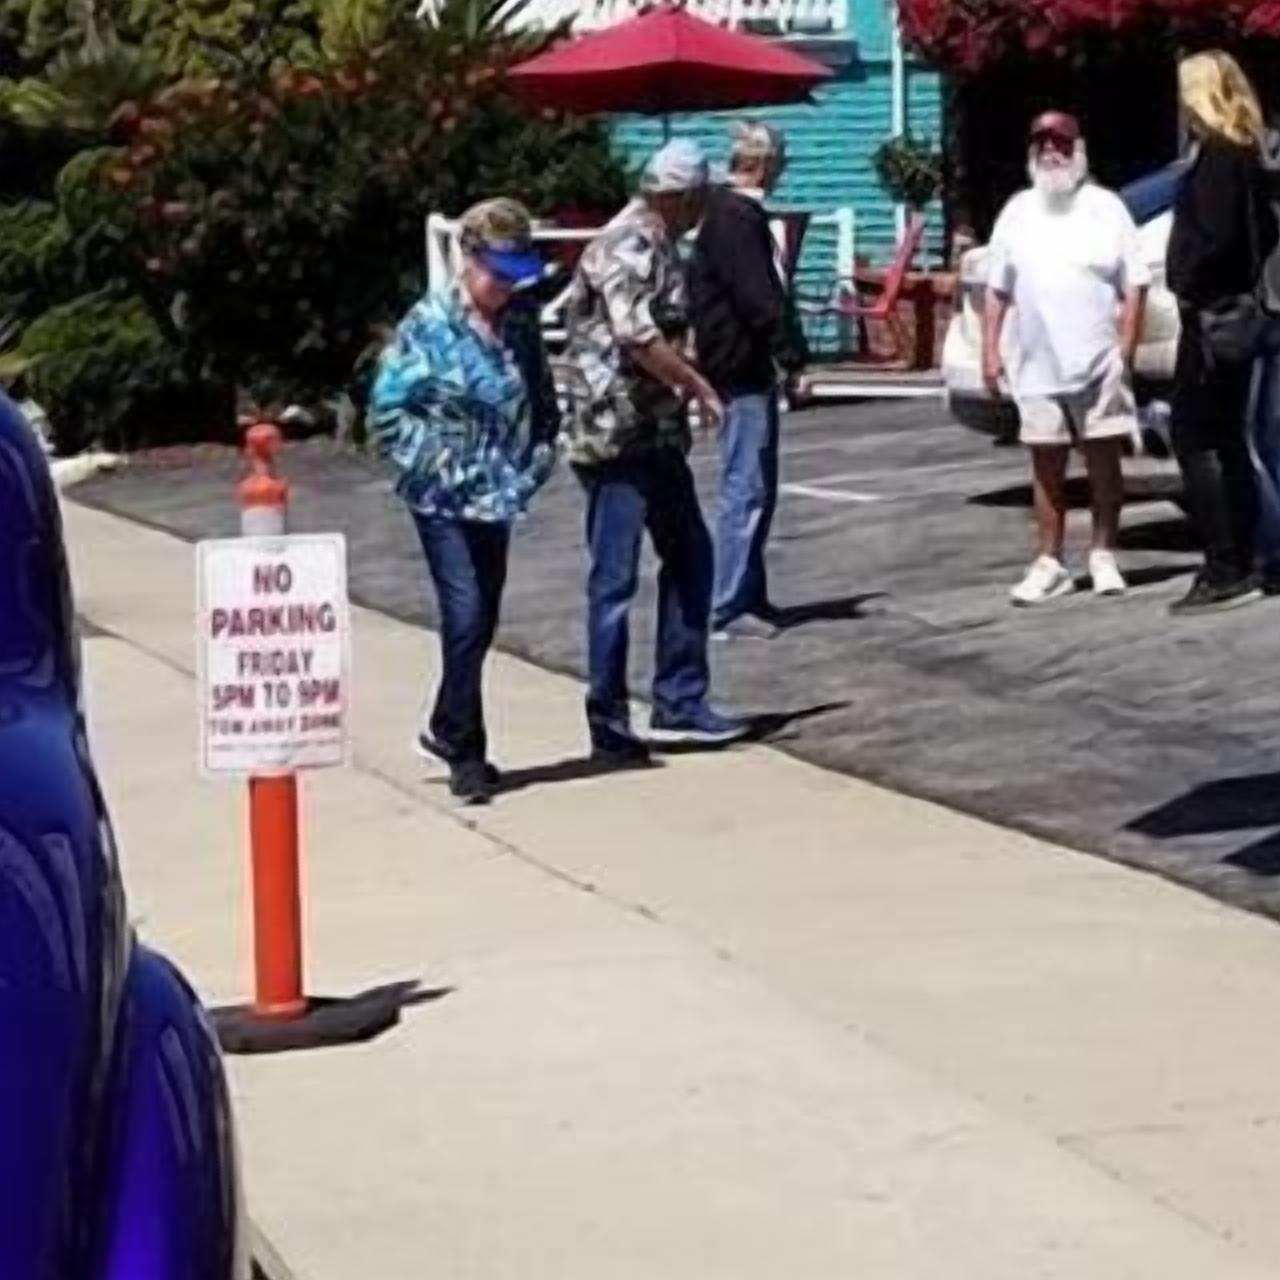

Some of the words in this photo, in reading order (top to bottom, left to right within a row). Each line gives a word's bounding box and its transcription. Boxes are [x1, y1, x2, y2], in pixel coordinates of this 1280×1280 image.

[253, 563, 293, 594] NO
[211, 602, 336, 638] PARKING
[237, 649, 314, 677] FRIDAY
[263, 681, 292, 708] TO
